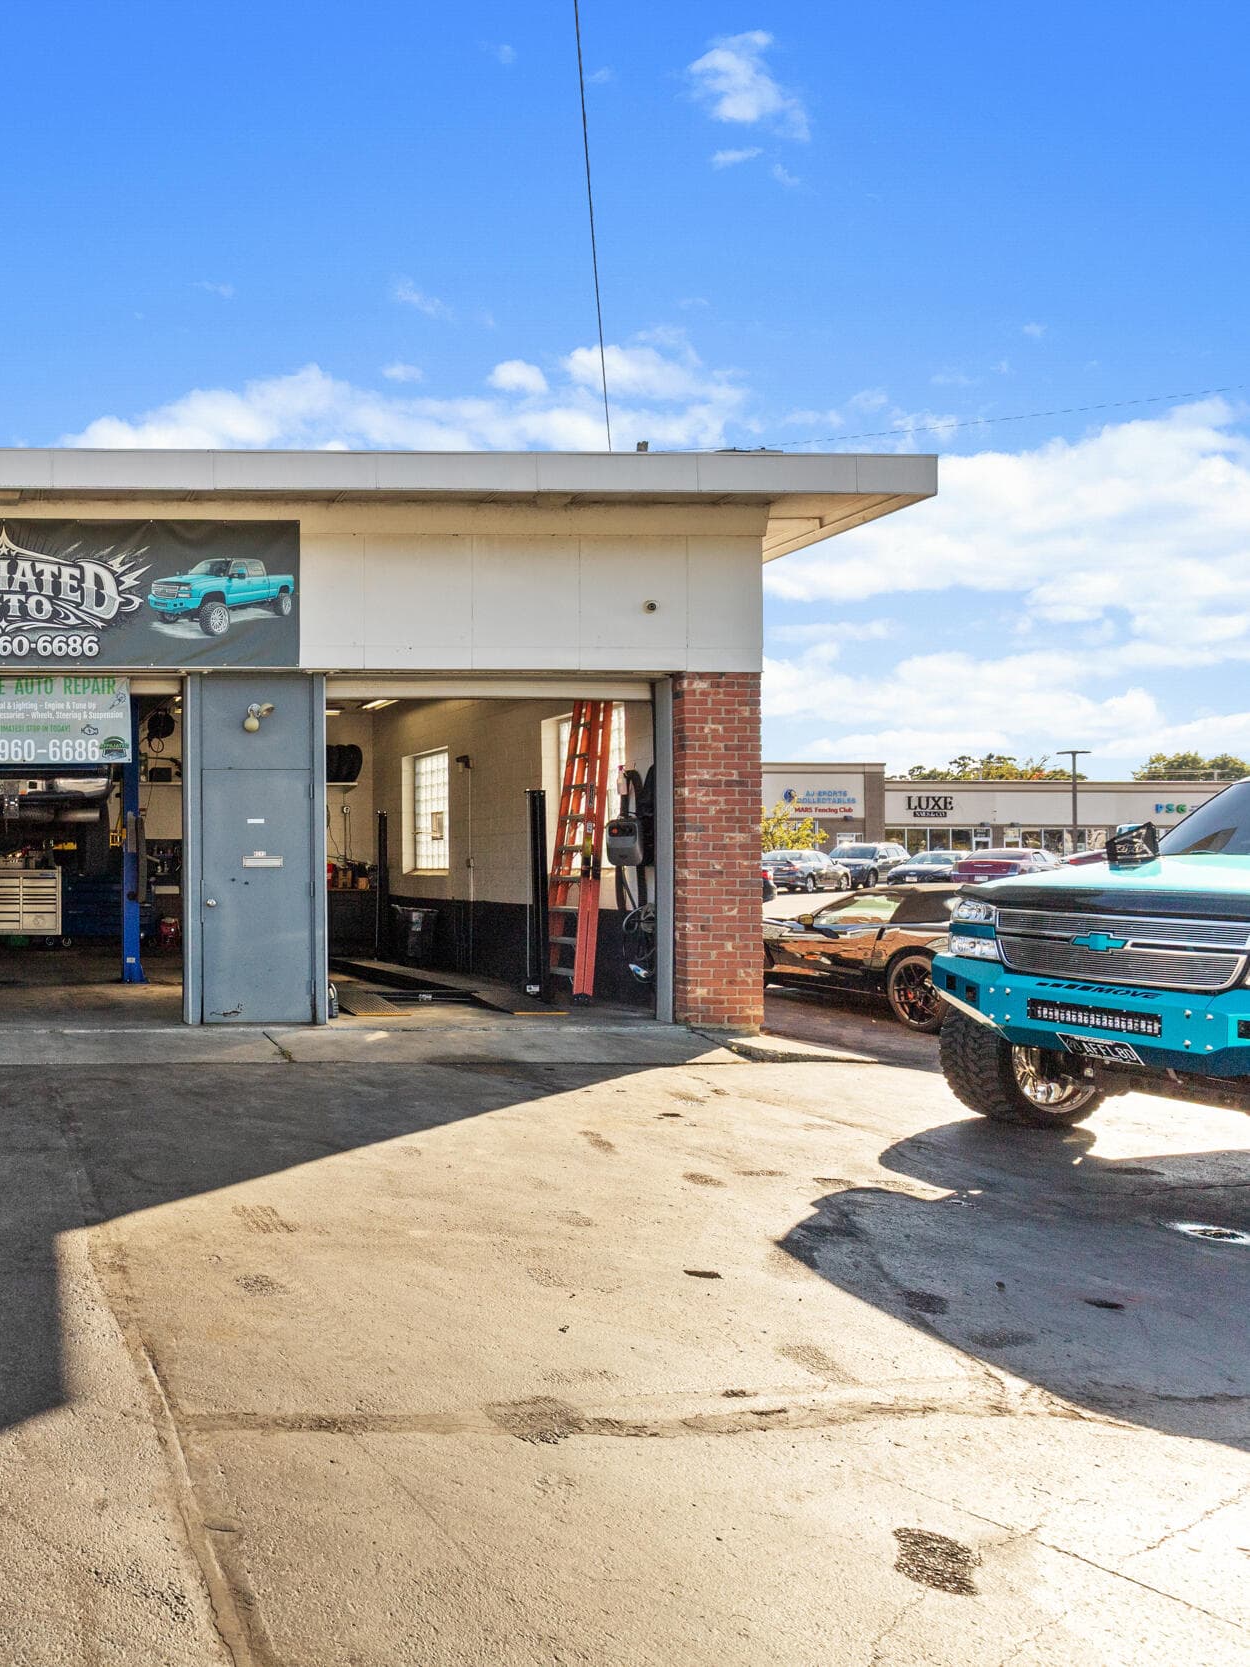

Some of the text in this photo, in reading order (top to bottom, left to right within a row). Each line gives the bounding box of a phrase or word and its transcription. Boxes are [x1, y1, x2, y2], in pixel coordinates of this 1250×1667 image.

[14, 677, 54, 695] AUTO
[63, 677, 116, 695] REPAIR
[13, 702, 38, 712] Lighting
[45, 702, 64, 711] Engine
[72, 702, 86, 710] Tune
[88, 702, 97, 711] Up
[56, 711, 82, 721] Steering
[89, 711, 124, 721] Suspension
[907, 795, 954, 811] LUXE
[815, 806, 838, 814] Fencing
